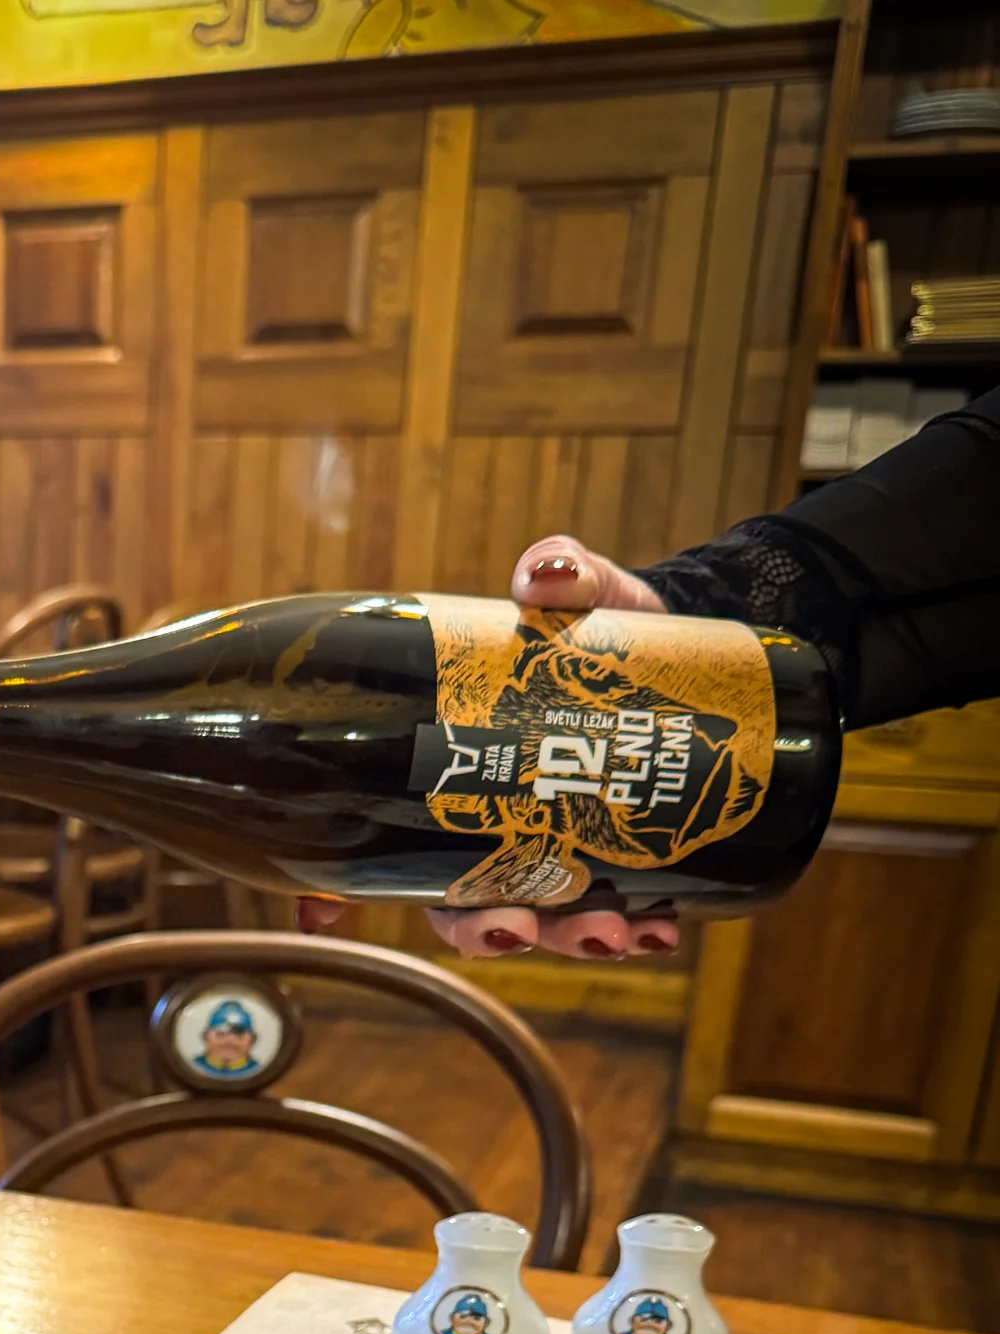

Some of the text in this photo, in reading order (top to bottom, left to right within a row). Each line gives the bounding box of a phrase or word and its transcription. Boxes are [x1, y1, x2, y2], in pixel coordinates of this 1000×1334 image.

[482, 744, 501, 781] ZLATÁ
[533, 735, 607, 801] 12
[605, 709, 655, 806] PLNO
[648, 714, 694, 809] TUČNÁ
